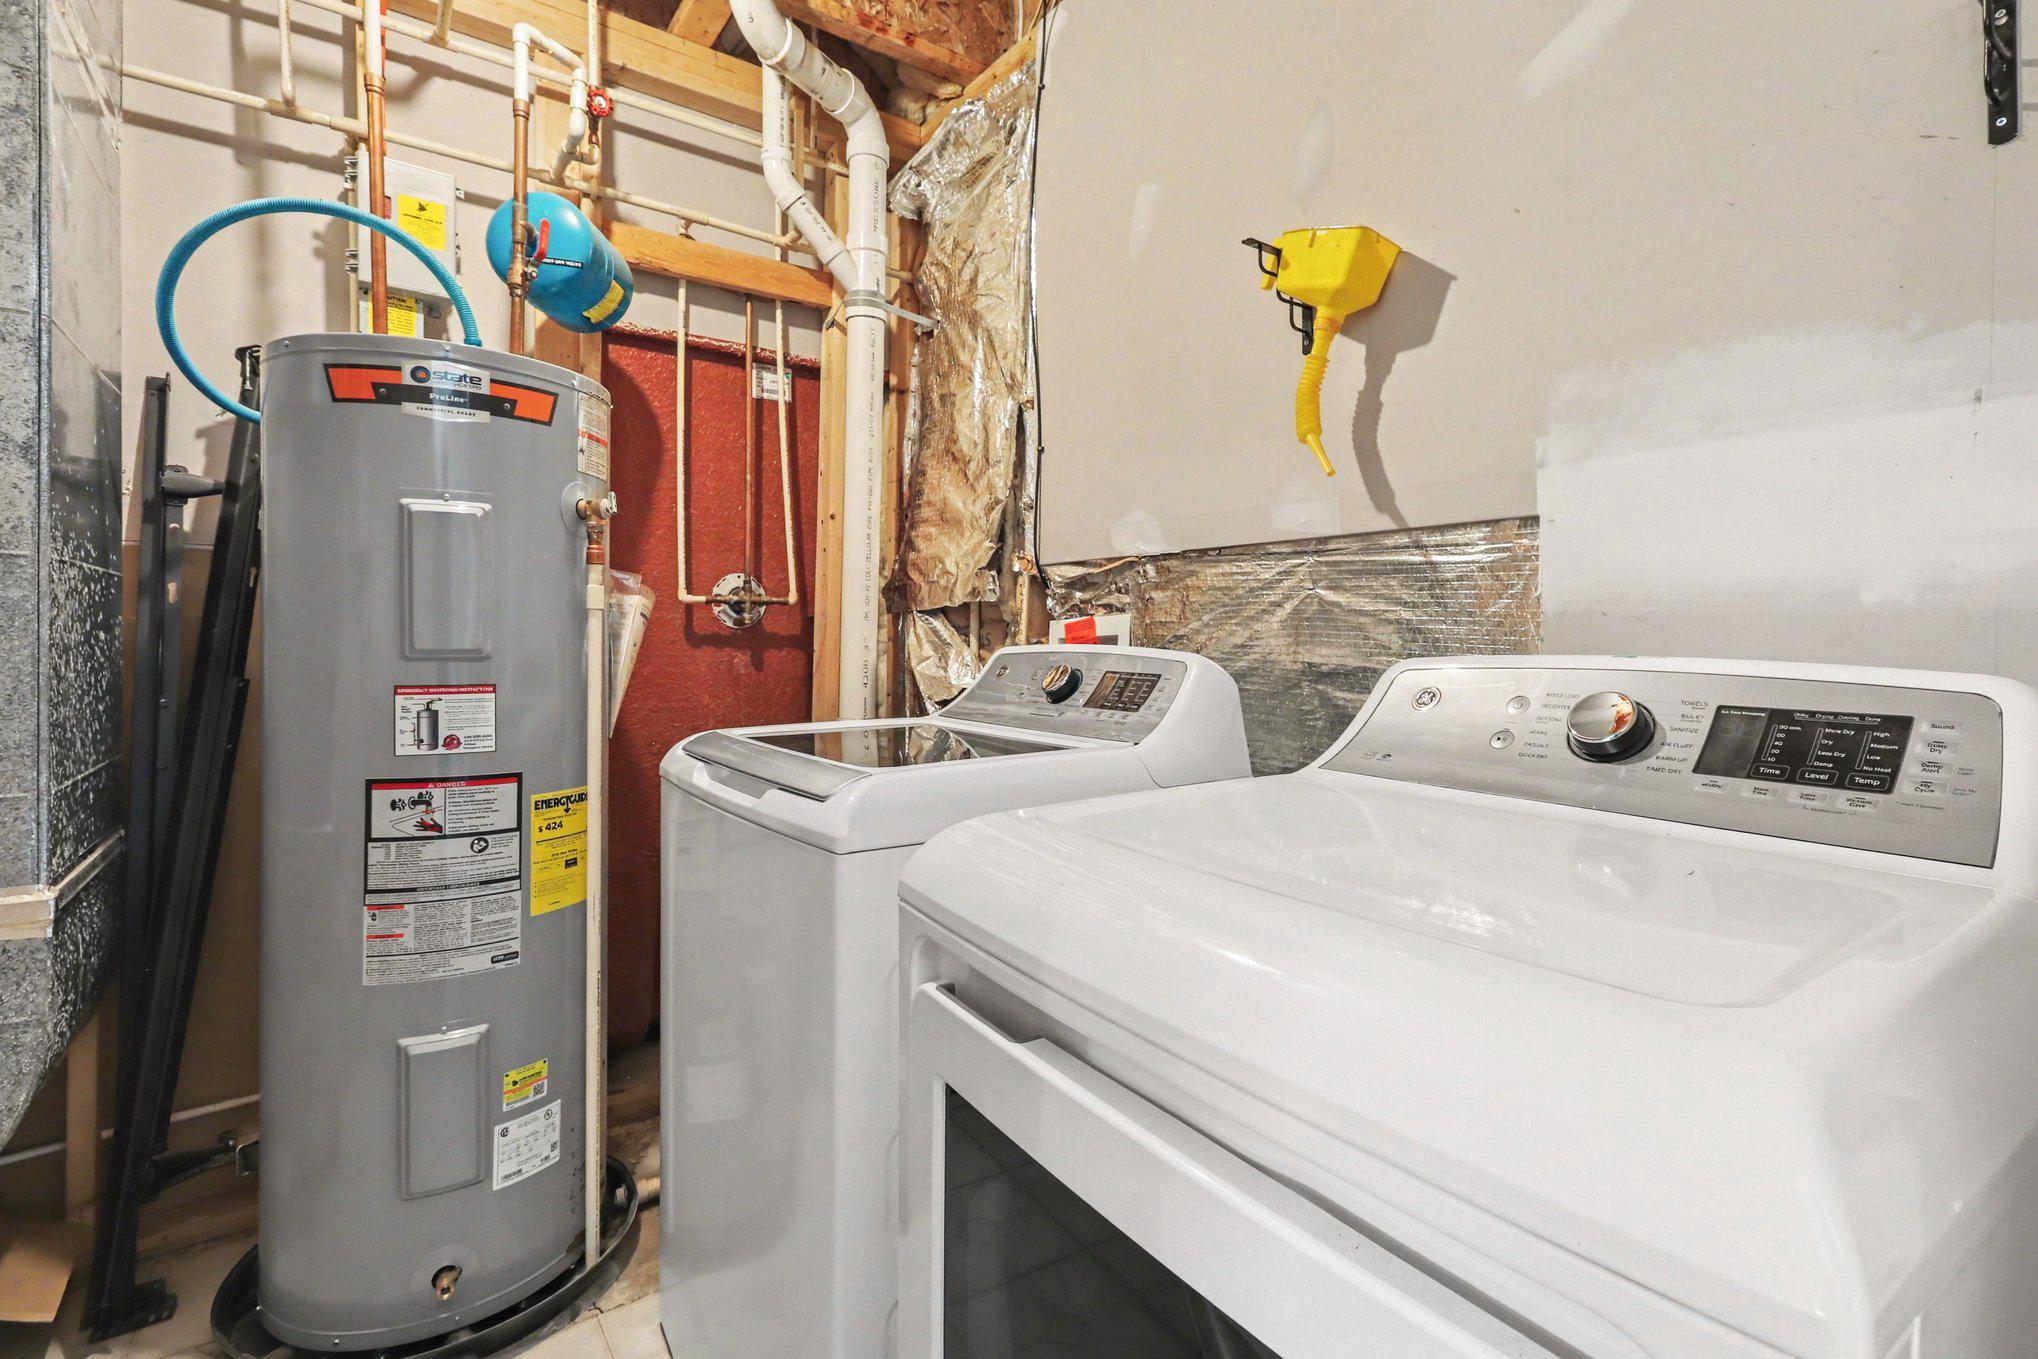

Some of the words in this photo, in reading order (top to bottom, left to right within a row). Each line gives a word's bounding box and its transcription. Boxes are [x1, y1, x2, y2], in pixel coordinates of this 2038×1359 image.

[432, 370, 482, 386] state
[862, 659, 870, 689] 4300
[1669, 726, 1699, 734] SANITIZE
[1758, 766, 1781, 775] Time
[1805, 772, 1829, 780] Level
[1854, 777, 1881, 787] Temp
[534, 791, 588, 812] ENERGYGUID
[545, 819, 563, 831] 424
